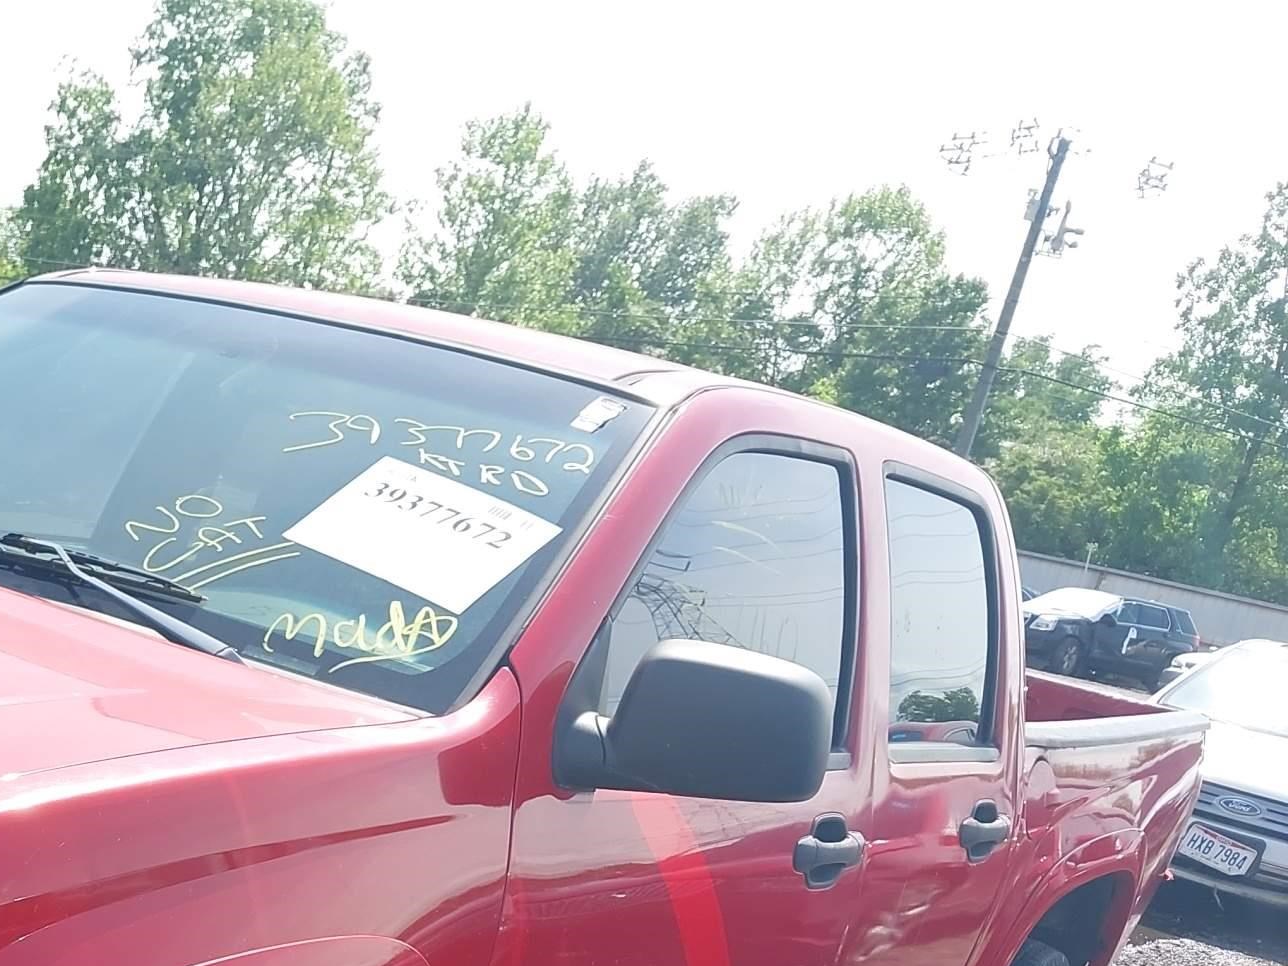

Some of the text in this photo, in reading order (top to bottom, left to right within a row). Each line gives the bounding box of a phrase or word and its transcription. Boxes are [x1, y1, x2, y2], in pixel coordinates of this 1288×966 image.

[363, 482, 513, 549] 39377672
[1186, 832, 1215, 856] HXB
[1213, 844, 1248, 871] 7984
